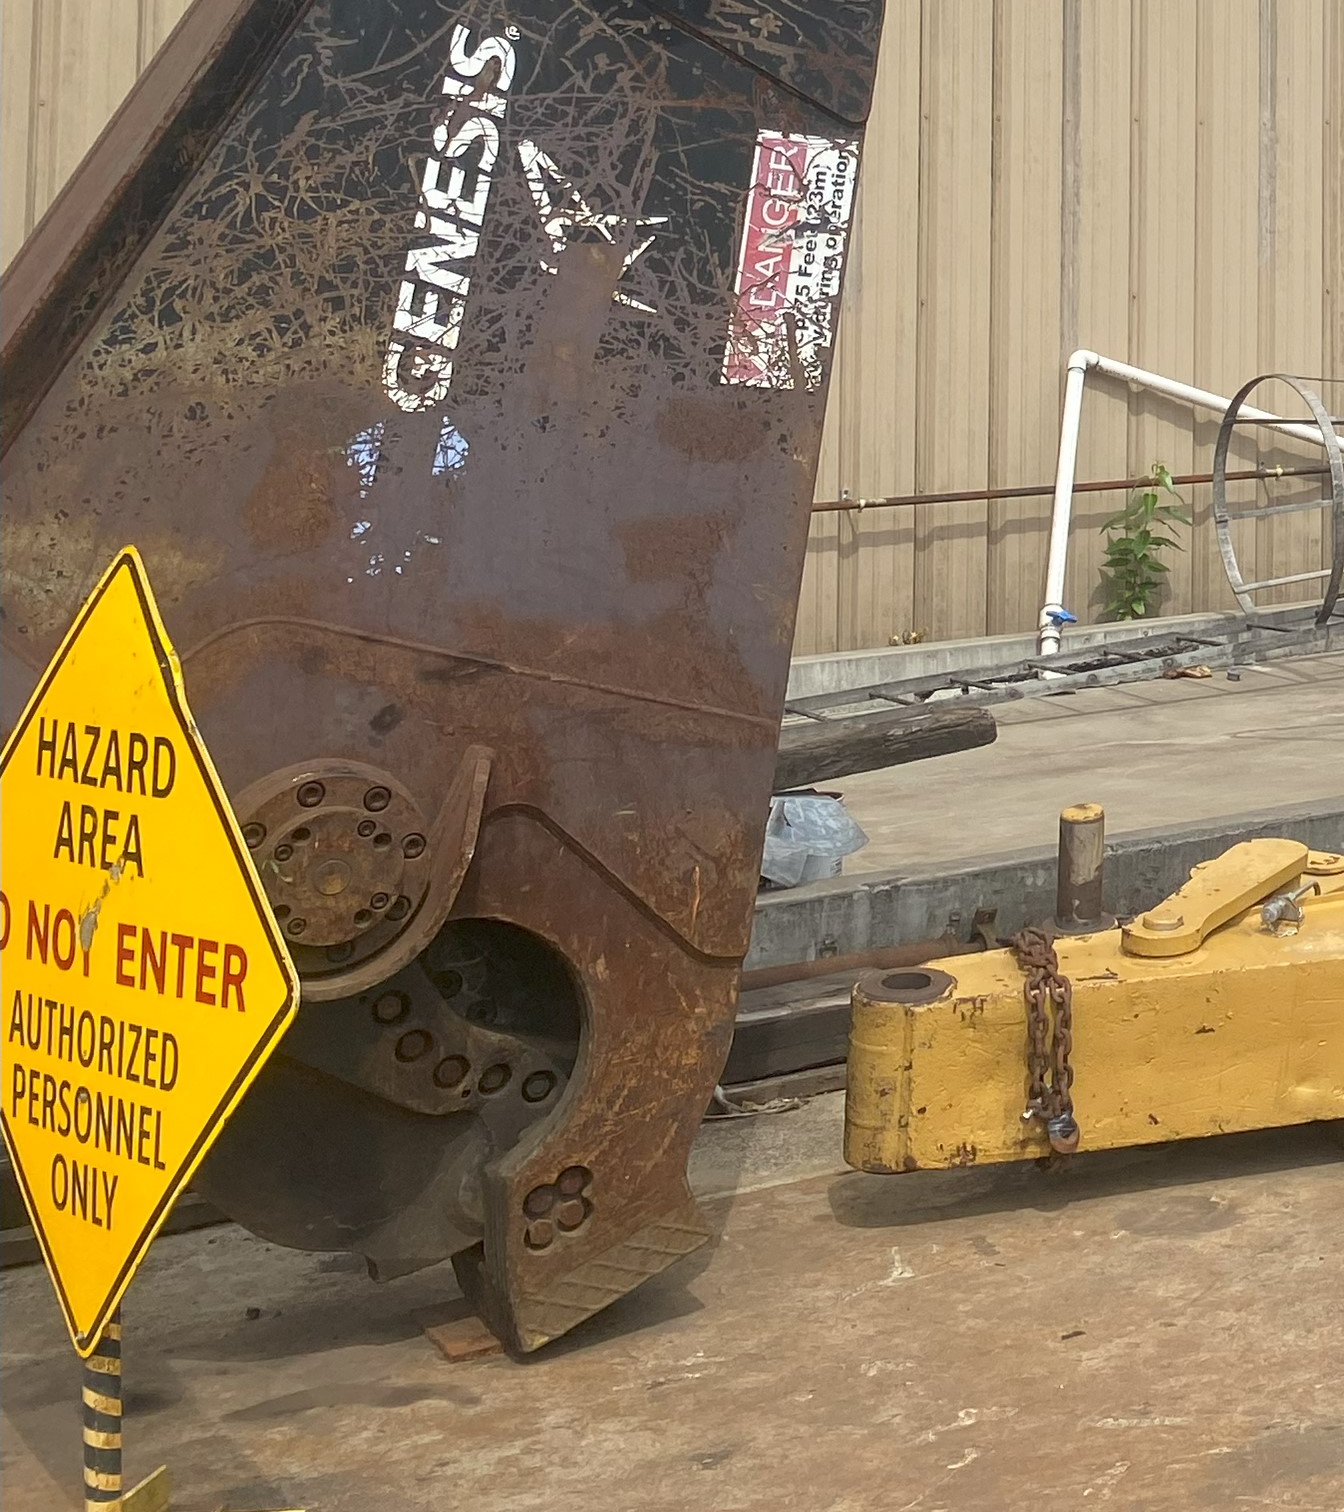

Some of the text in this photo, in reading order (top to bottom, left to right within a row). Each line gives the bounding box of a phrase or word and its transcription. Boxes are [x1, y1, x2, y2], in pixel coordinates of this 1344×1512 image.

[382, 23, 516, 413] GENESIS
[749, 145, 799, 308] DANGER
[798, 229, 819, 277] Feet
[36, 716, 177, 799] HAZARD
[53, 800, 144, 879] AREA
[115, 922, 249, 1013] ENTER
[8, 989, 179, 1093] AUTHORIZED
[12, 1063, 167, 1171] PERSONNEL
[51, 1152, 119, 1232] ONLY
